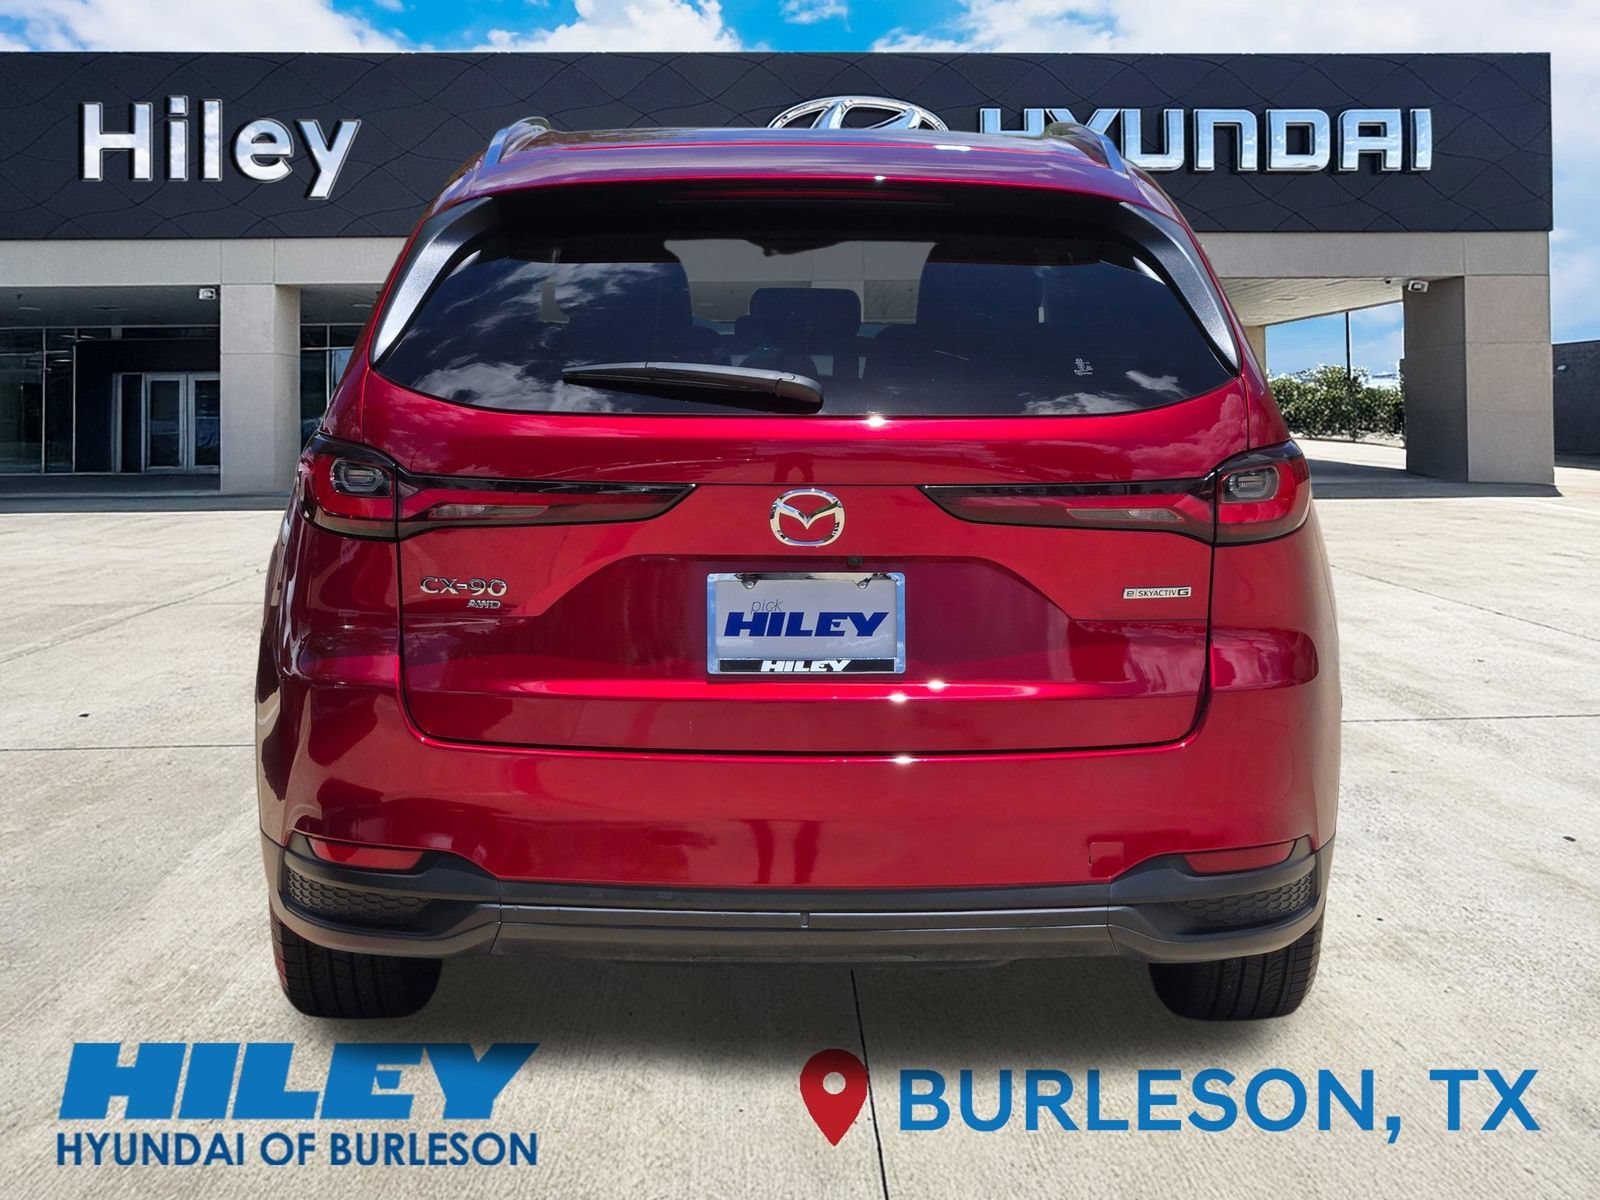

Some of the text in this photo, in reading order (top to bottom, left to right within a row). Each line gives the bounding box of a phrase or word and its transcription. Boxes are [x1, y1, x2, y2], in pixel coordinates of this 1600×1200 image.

[81, 95, 362, 200] Hiley
[420, 576, 508, 597] CX-90
[467, 599, 501, 609] AWD
[750, 598, 785, 613] pick
[724, 611, 889, 637] HILEY
[760, 660, 852, 672] HILEY
